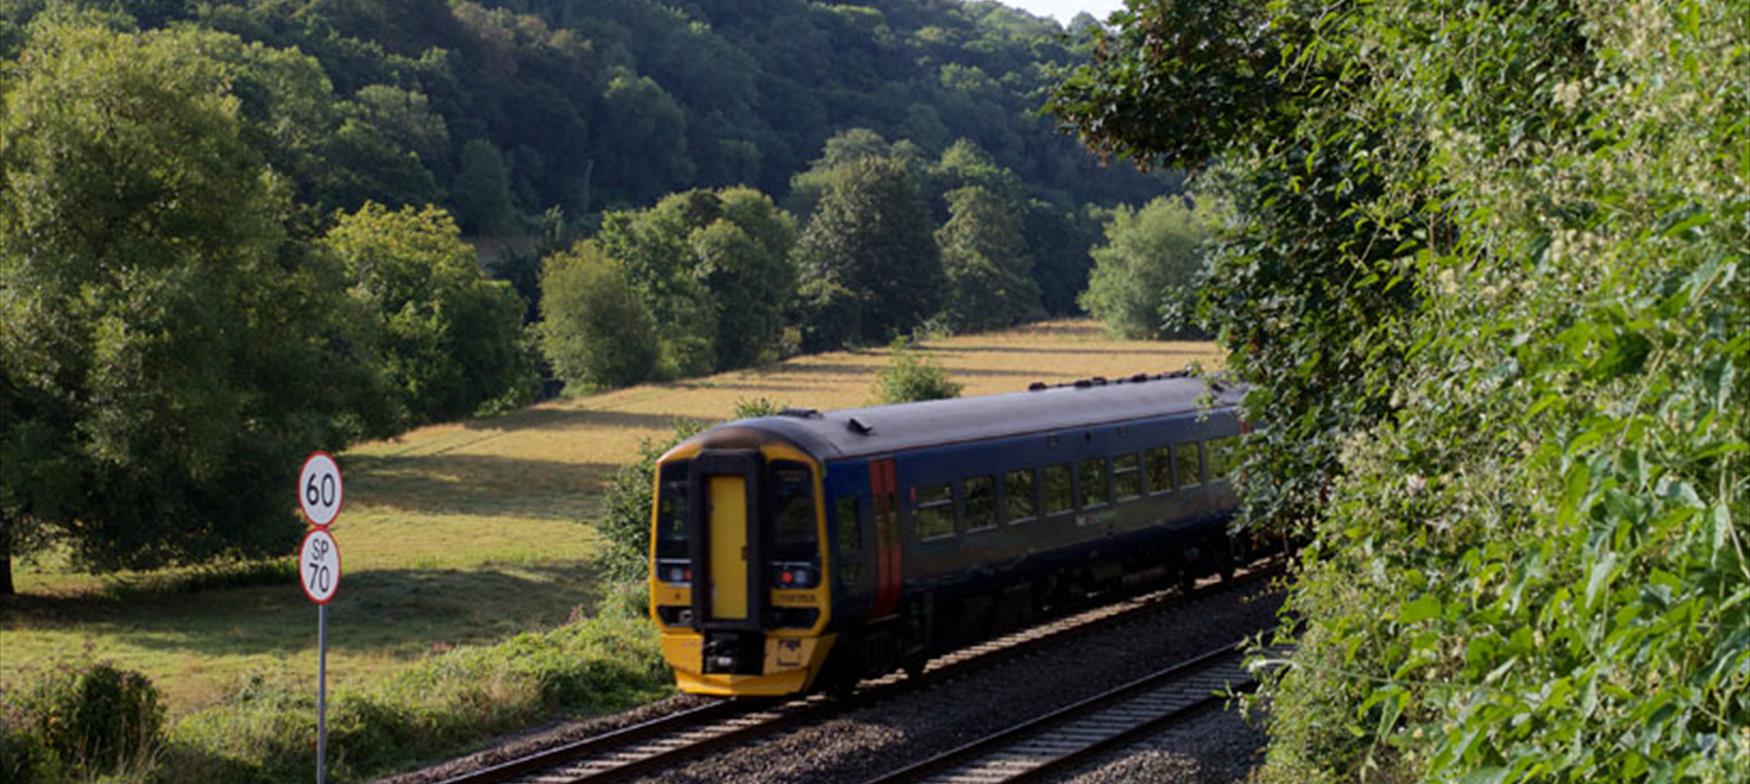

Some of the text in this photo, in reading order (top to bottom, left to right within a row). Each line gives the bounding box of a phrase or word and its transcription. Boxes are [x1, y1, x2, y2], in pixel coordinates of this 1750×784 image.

[306, 473, 335, 507] 60
[312, 539, 329, 561] SP
[309, 563, 330, 593] 70
